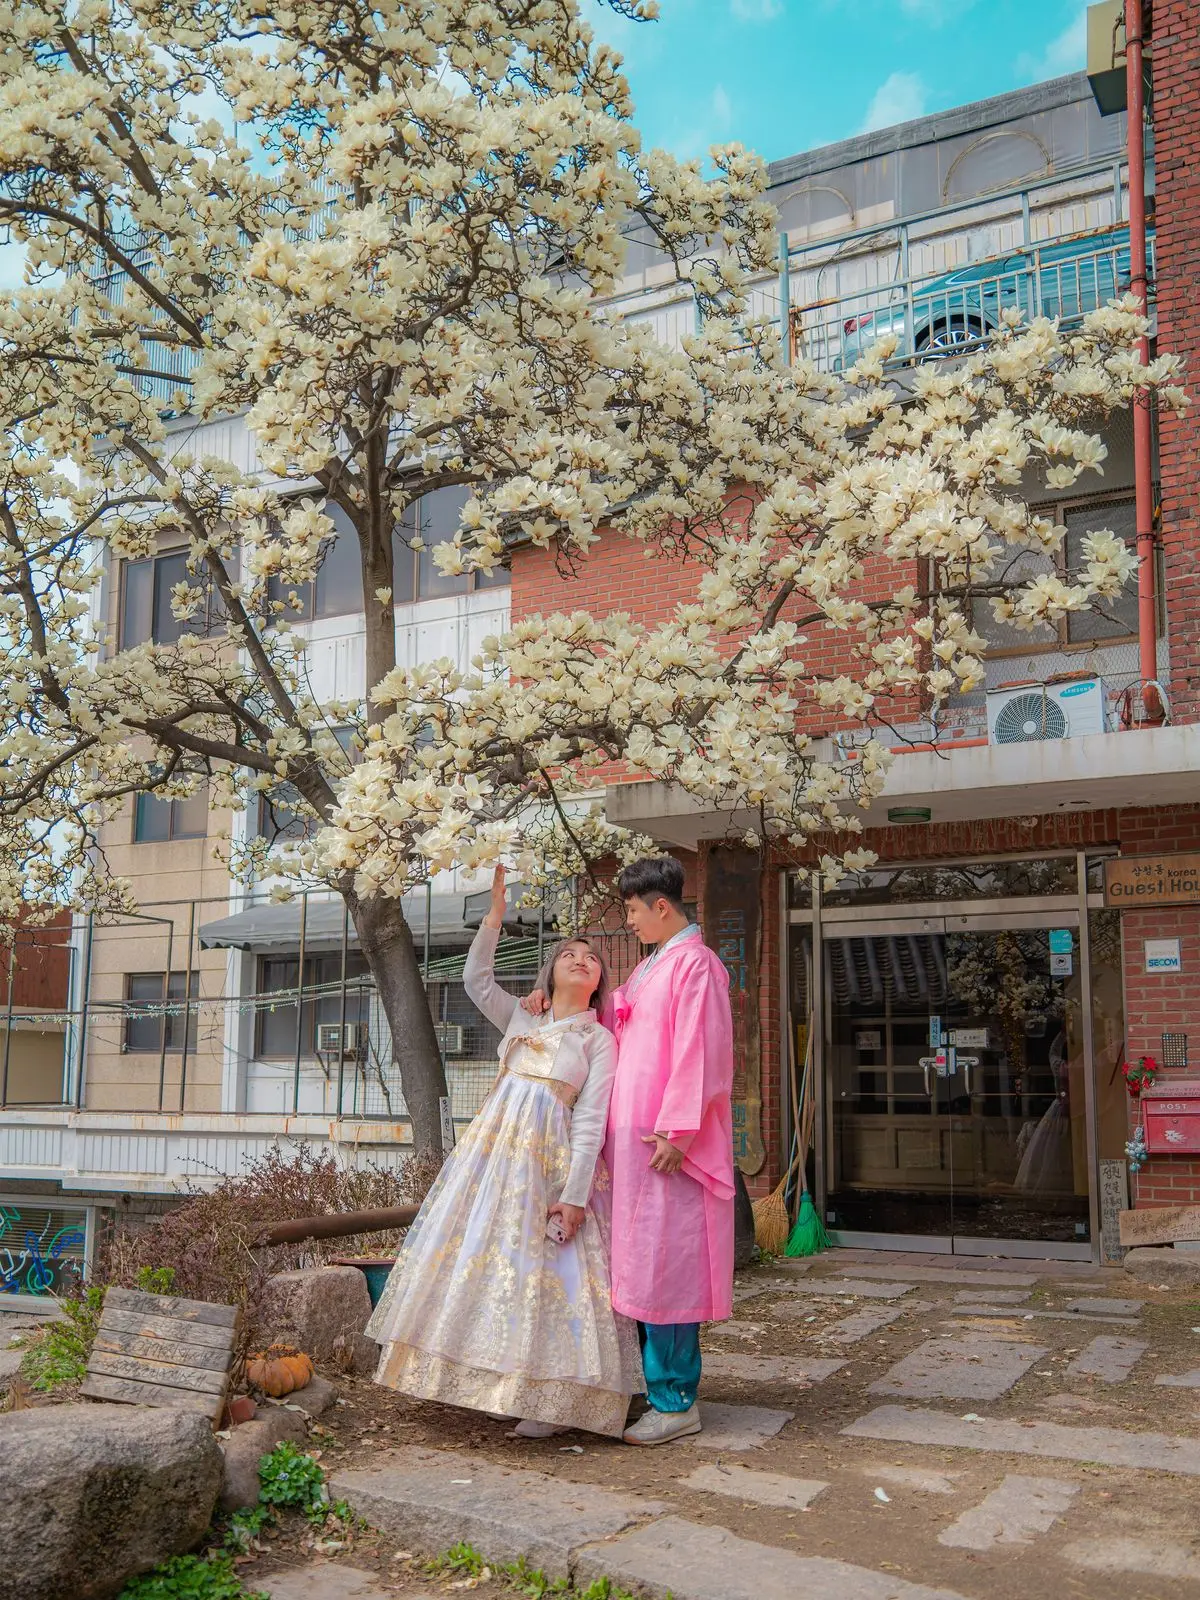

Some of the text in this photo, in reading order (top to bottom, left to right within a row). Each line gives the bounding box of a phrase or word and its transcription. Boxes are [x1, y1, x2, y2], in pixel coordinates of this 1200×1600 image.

[1167, 868, 1197, 877] korea
[1109, 880, 1164, 897] Guest
[1148, 958, 1178, 967] SECOM
